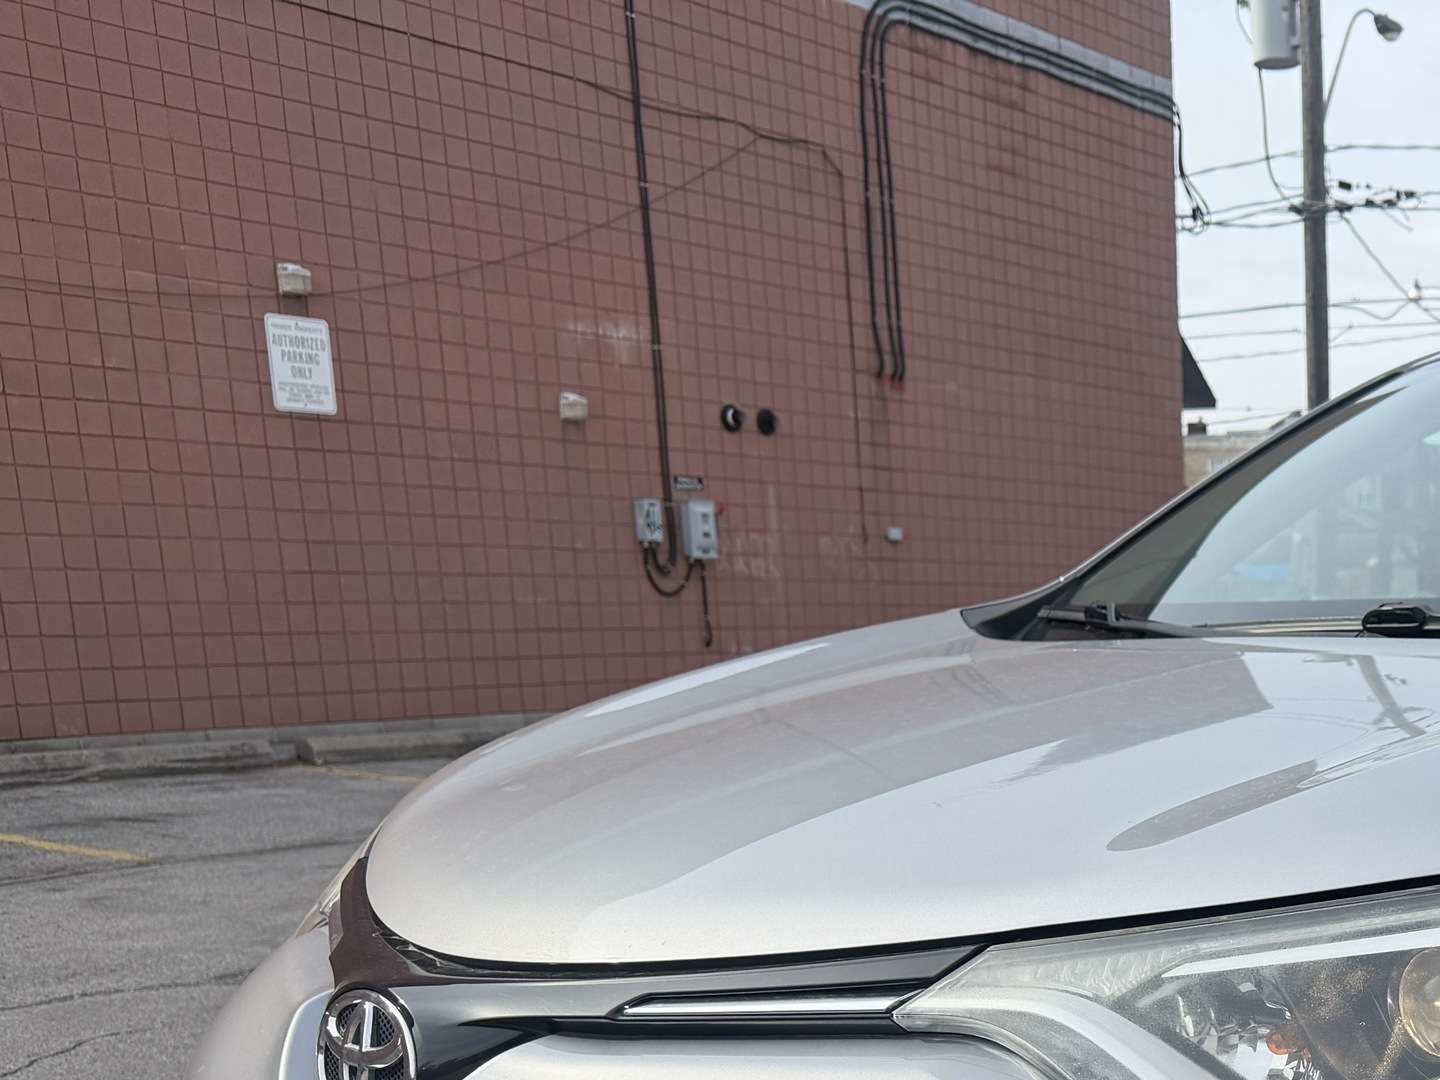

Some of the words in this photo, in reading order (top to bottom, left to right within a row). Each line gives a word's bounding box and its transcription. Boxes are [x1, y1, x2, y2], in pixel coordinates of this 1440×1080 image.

[272, 333, 327, 353] AUTHORIZED
[281, 349, 321, 366] PARKING
[290, 365, 313, 380] ONLY
